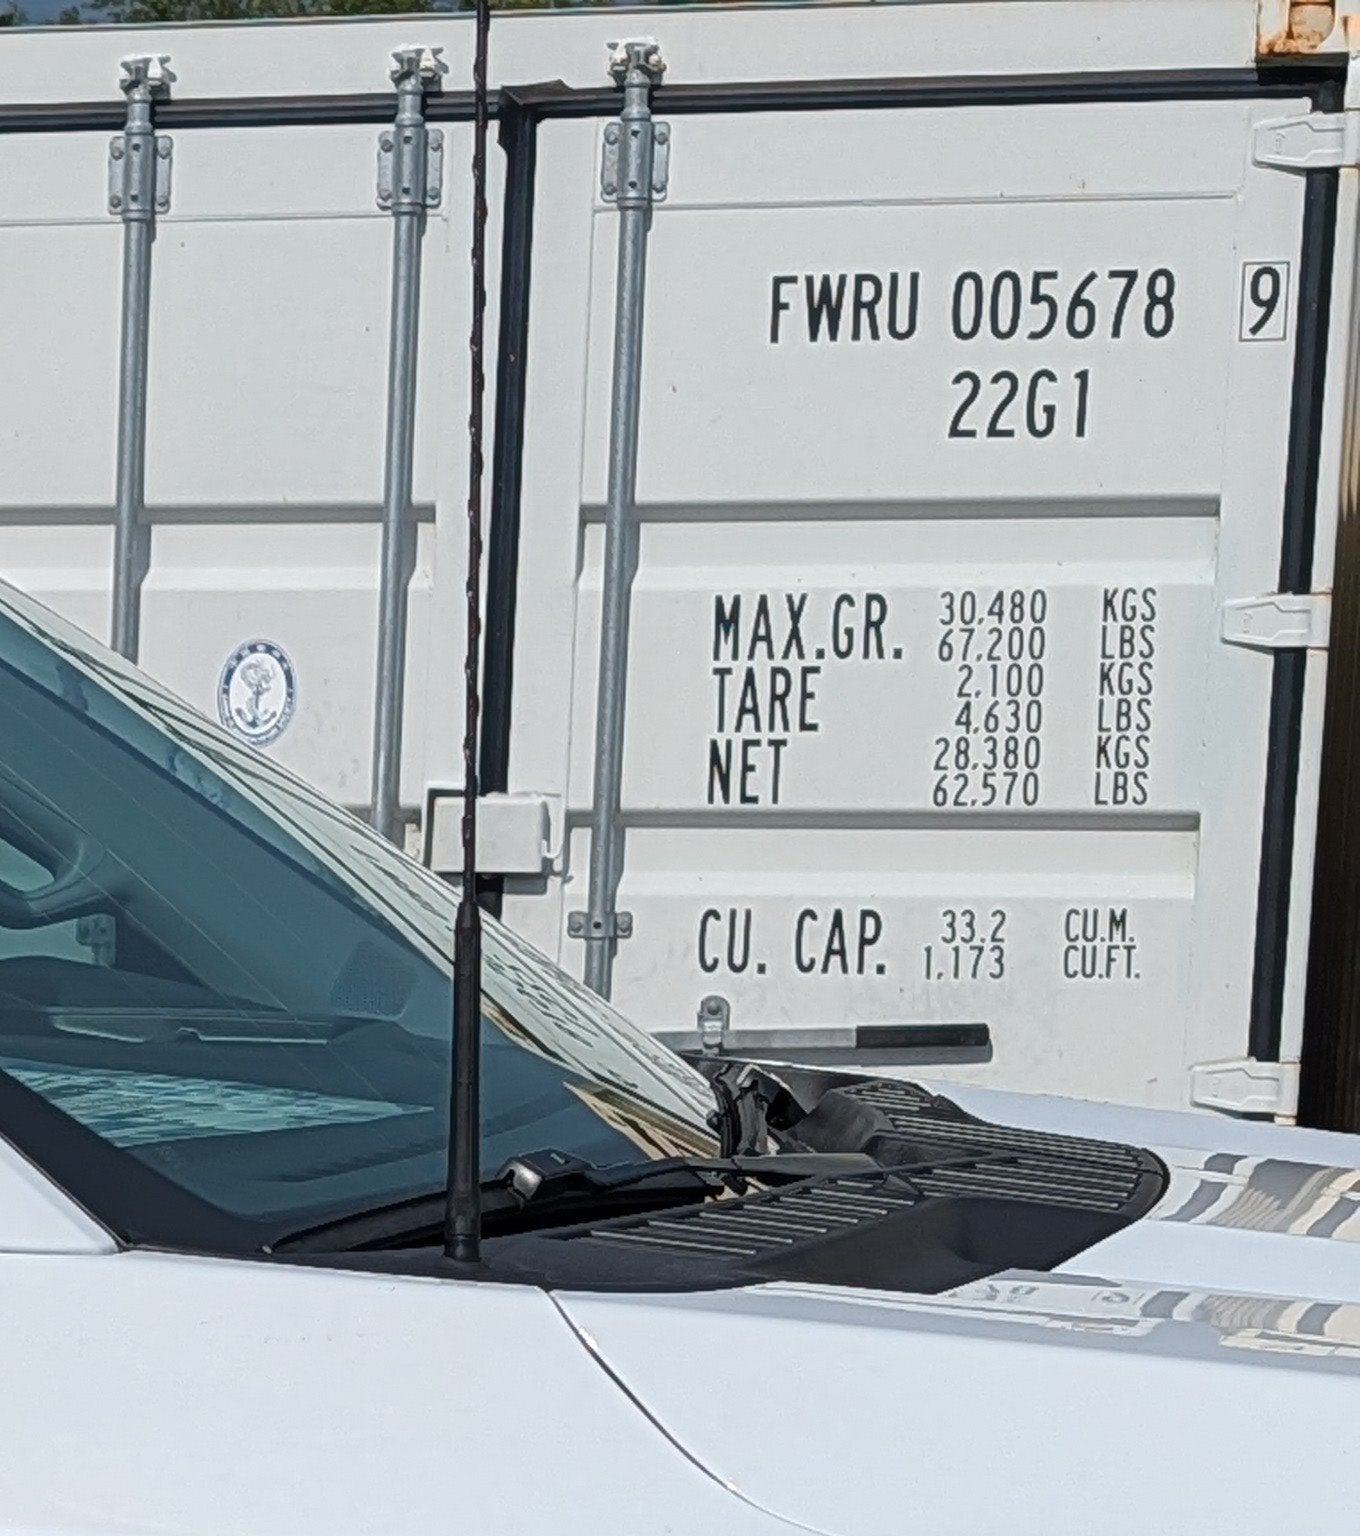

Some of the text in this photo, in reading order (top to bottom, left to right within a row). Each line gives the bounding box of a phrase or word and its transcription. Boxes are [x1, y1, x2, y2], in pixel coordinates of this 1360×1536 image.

[770, 266, 1280, 343] FWRU 005678 9
[948, 368, 1089, 439] 22G1
[1103, 587, 1156, 622] KGS
[713, 593, 903, 661] MAX.GR.
[1101, 624, 1155, 660] LBS
[1099, 661, 1153, 696] KGS
[712, 665, 821, 733] TARE
[1098, 698, 1151, 733] LBS
[1096, 734, 1149, 769] KGS
[707, 738, 788, 805] NET
[1094, 771, 1148, 806] LBS
[698, 908, 886, 975] CU. CAP.
[941, 909, 1007, 944] 33.2
